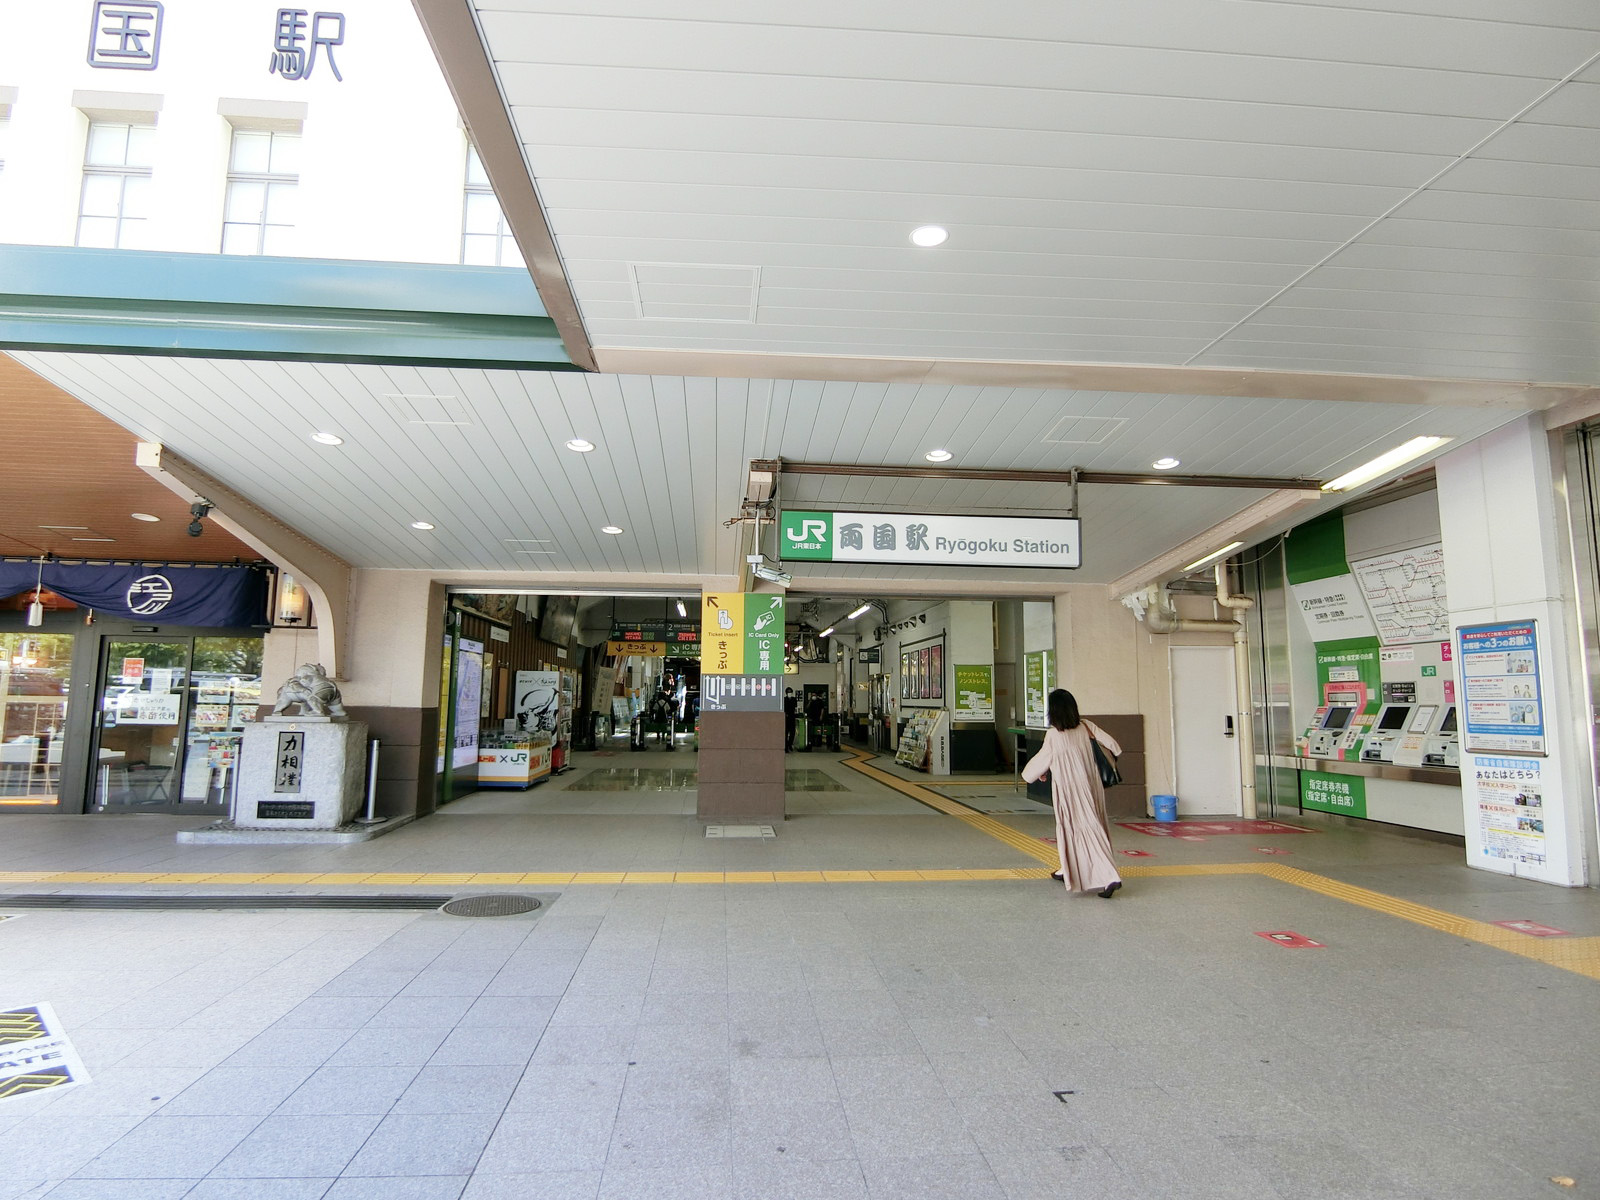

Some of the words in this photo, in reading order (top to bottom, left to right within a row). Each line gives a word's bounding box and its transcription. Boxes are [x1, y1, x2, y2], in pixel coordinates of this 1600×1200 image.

[787, 520, 827, 542] JR
[792, 542, 822, 550] JR東日本
[935, 536, 1008, 555] Ryōgoku
[1013, 538, 1070, 554] Station
[668, 623, 674, 631] 2
[1463, 635, 1532, 650] お客様への3つのお願い
[717, 640, 728, 670] きっぷ
[1423, 667, 1435, 676] JR
[510, 753, 527, 762] JR
[1476, 770, 1541, 779] あなたはどちら？
[1308, 779, 1350, 795] 指定席券売機
